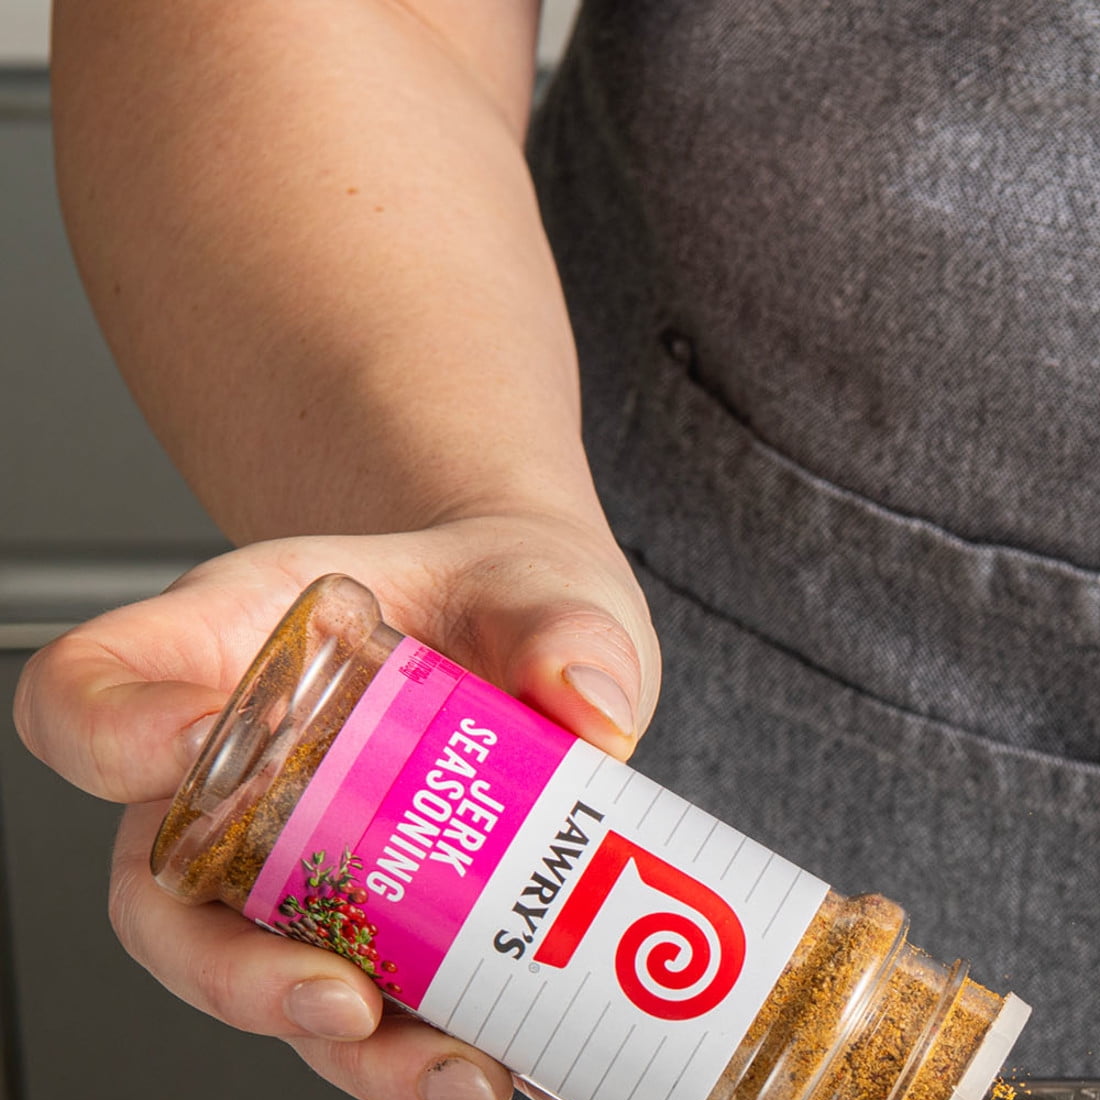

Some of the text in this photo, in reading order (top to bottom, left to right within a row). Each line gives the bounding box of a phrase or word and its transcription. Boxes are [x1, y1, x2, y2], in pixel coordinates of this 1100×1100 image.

[365, 718, 498, 902] SEASONING
[429, 779, 505, 877] JERK
[493, 800, 605, 960] LAWRY'S
